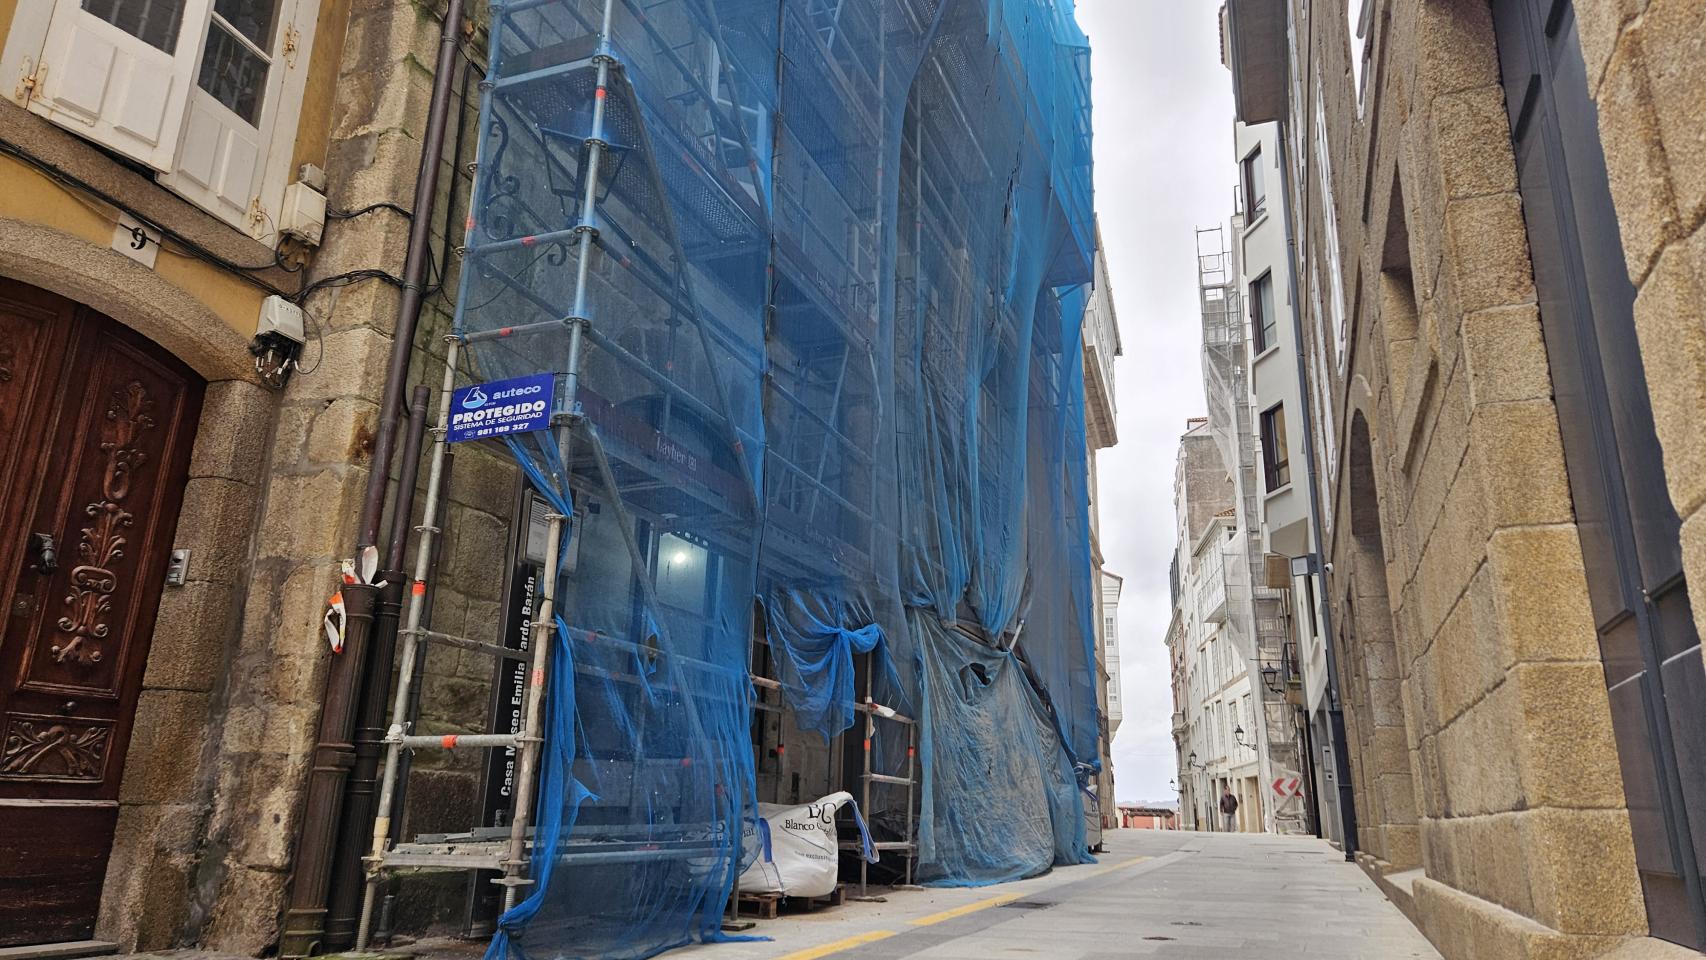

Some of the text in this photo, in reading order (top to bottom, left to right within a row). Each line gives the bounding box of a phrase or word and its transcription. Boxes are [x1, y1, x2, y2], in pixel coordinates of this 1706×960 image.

[131, 227, 147, 250] 9
[493, 385, 541, 399] auteco
[452, 400, 546, 425] PROTEGIDO
[453, 412, 543, 431] SISTEMA DE SEGURIDAD
[477, 427, 492, 436] 981
[512, 422, 530, 431] 327
[500, 576, 535, 796] Casa Mseo Emilia ardo Bazán
[785, 819, 815, 831] Blanco
